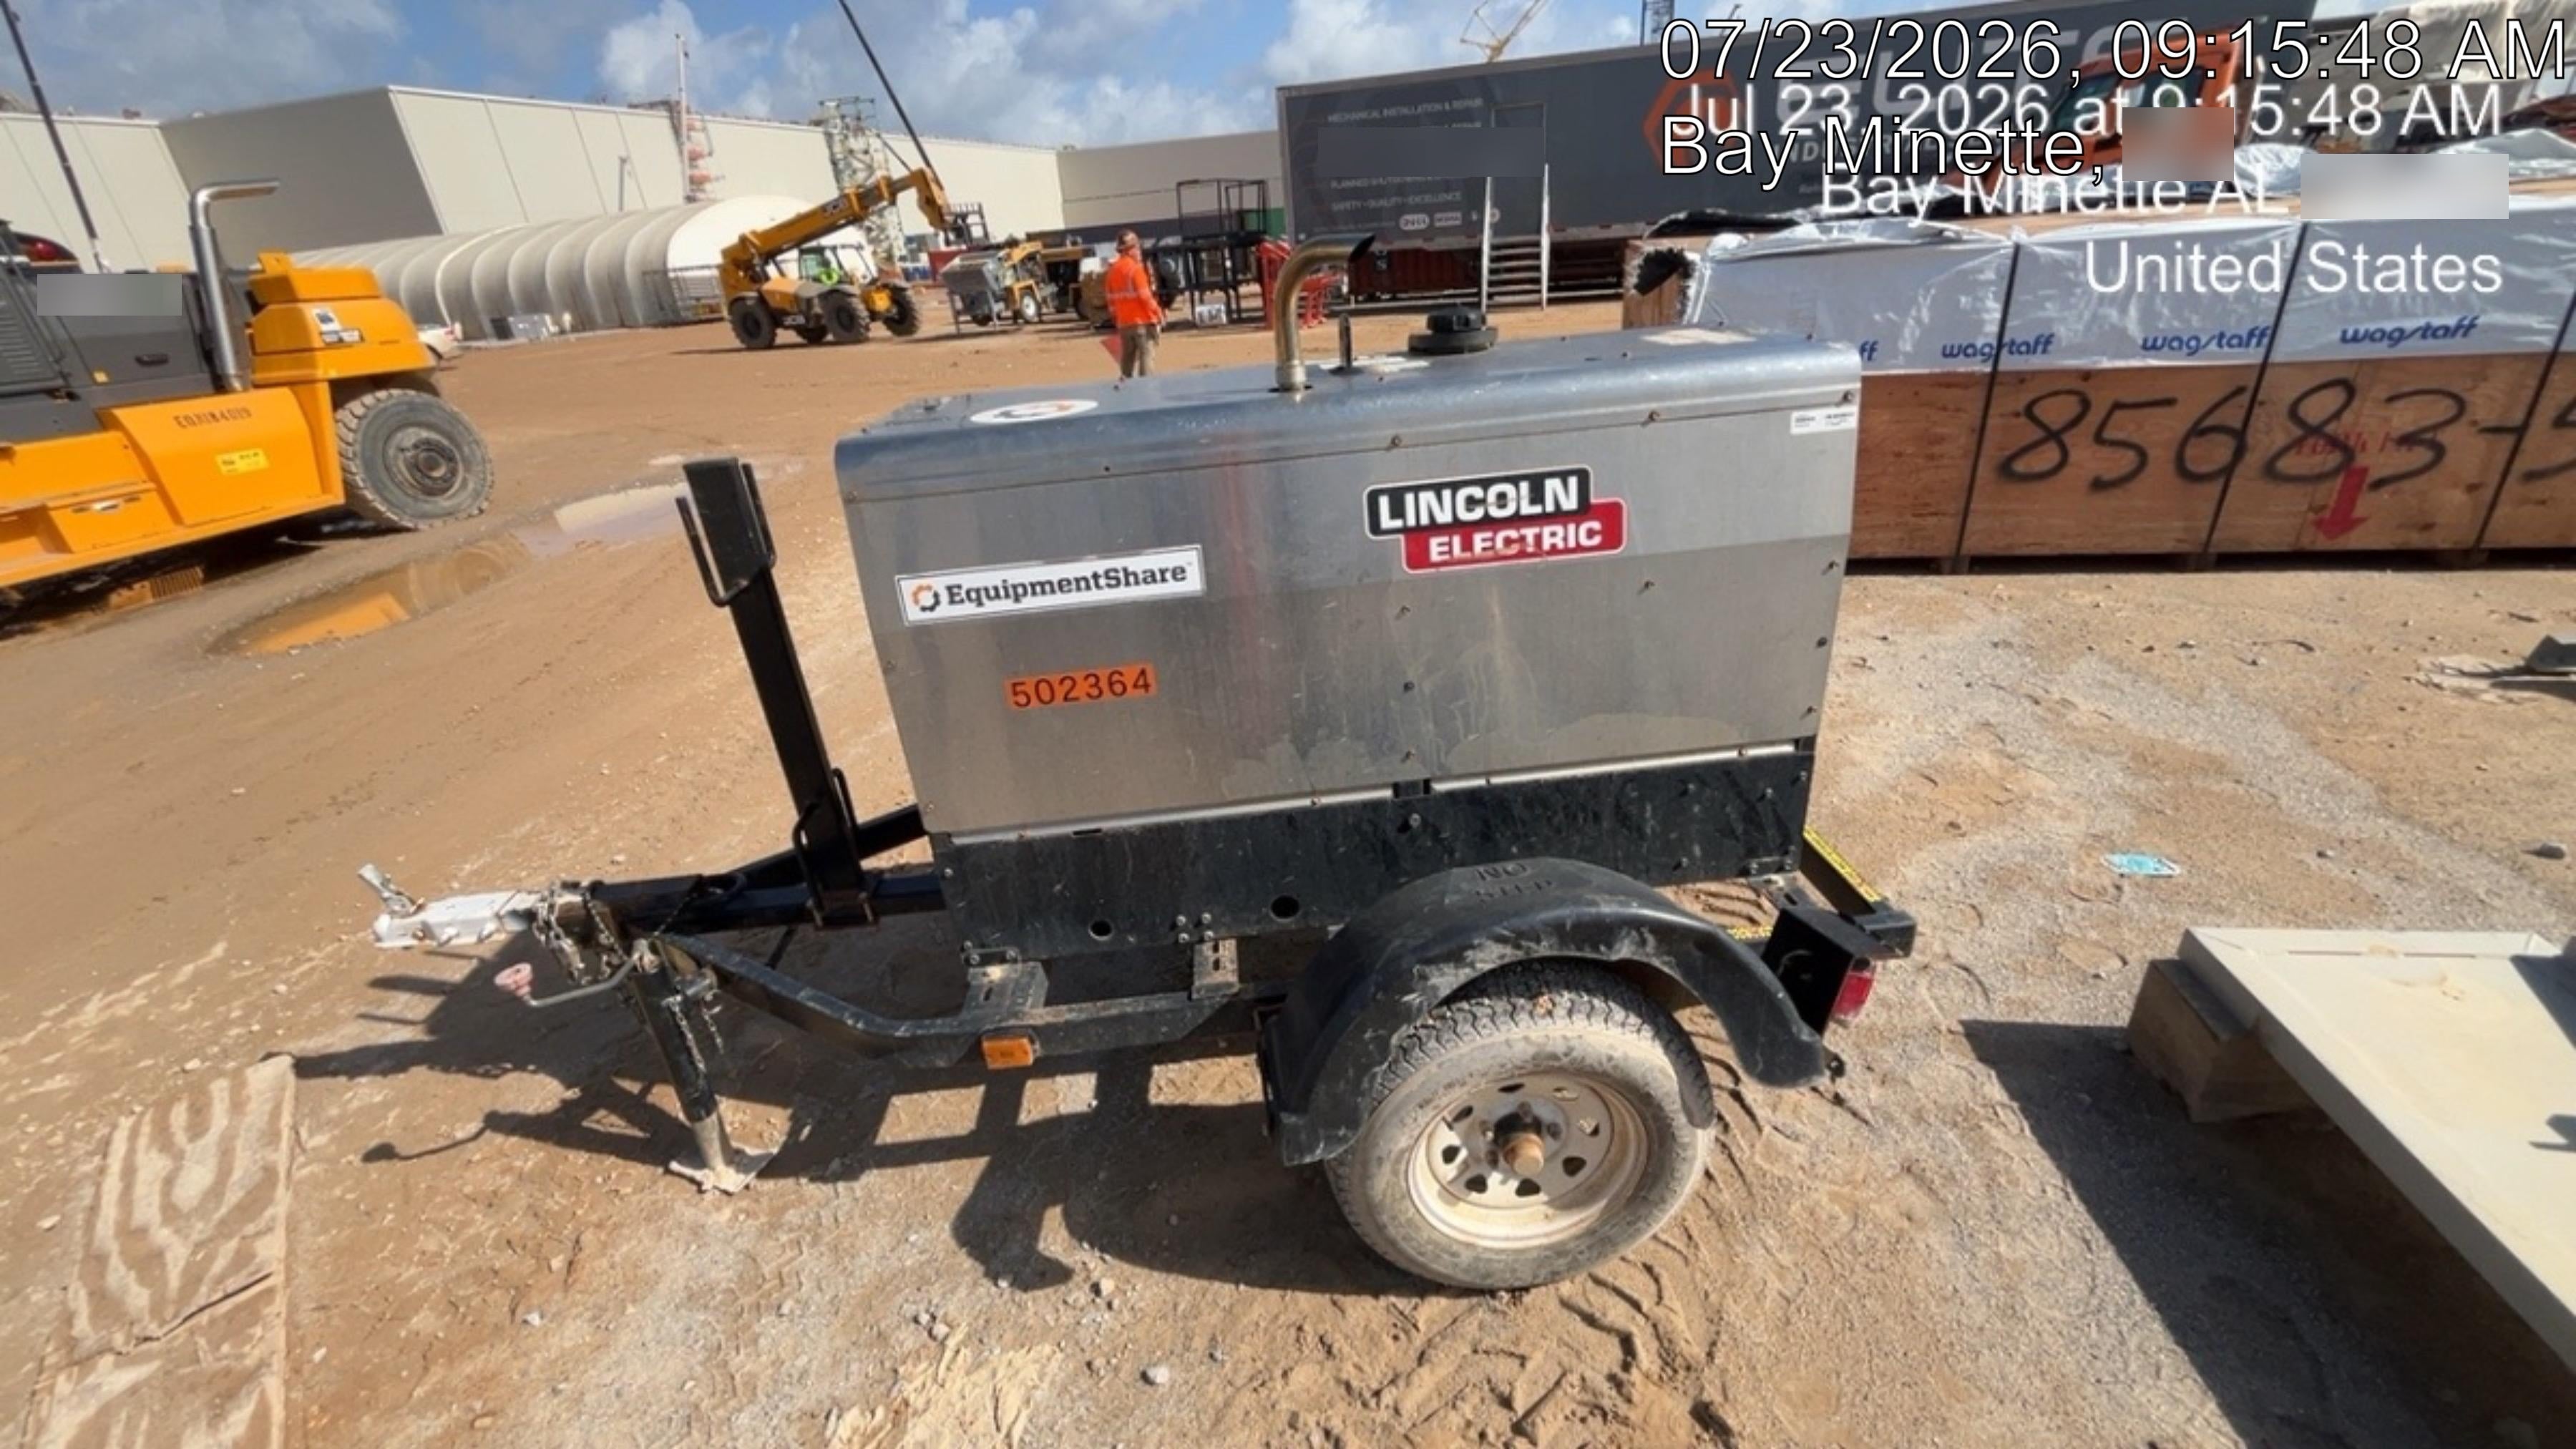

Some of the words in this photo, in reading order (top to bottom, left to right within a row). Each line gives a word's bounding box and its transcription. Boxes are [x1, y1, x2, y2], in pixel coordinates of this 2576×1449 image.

[2141, 326, 2270, 356] wagstaff
[2341, 316, 2479, 348] wagstaff
[1378, 476, 1579, 530] LINCOLN
[1429, 520, 1603, 563] ELECTRIC
[945, 564, 1189, 608] EquipmentShare
[1010, 666, 1152, 708] 502364
